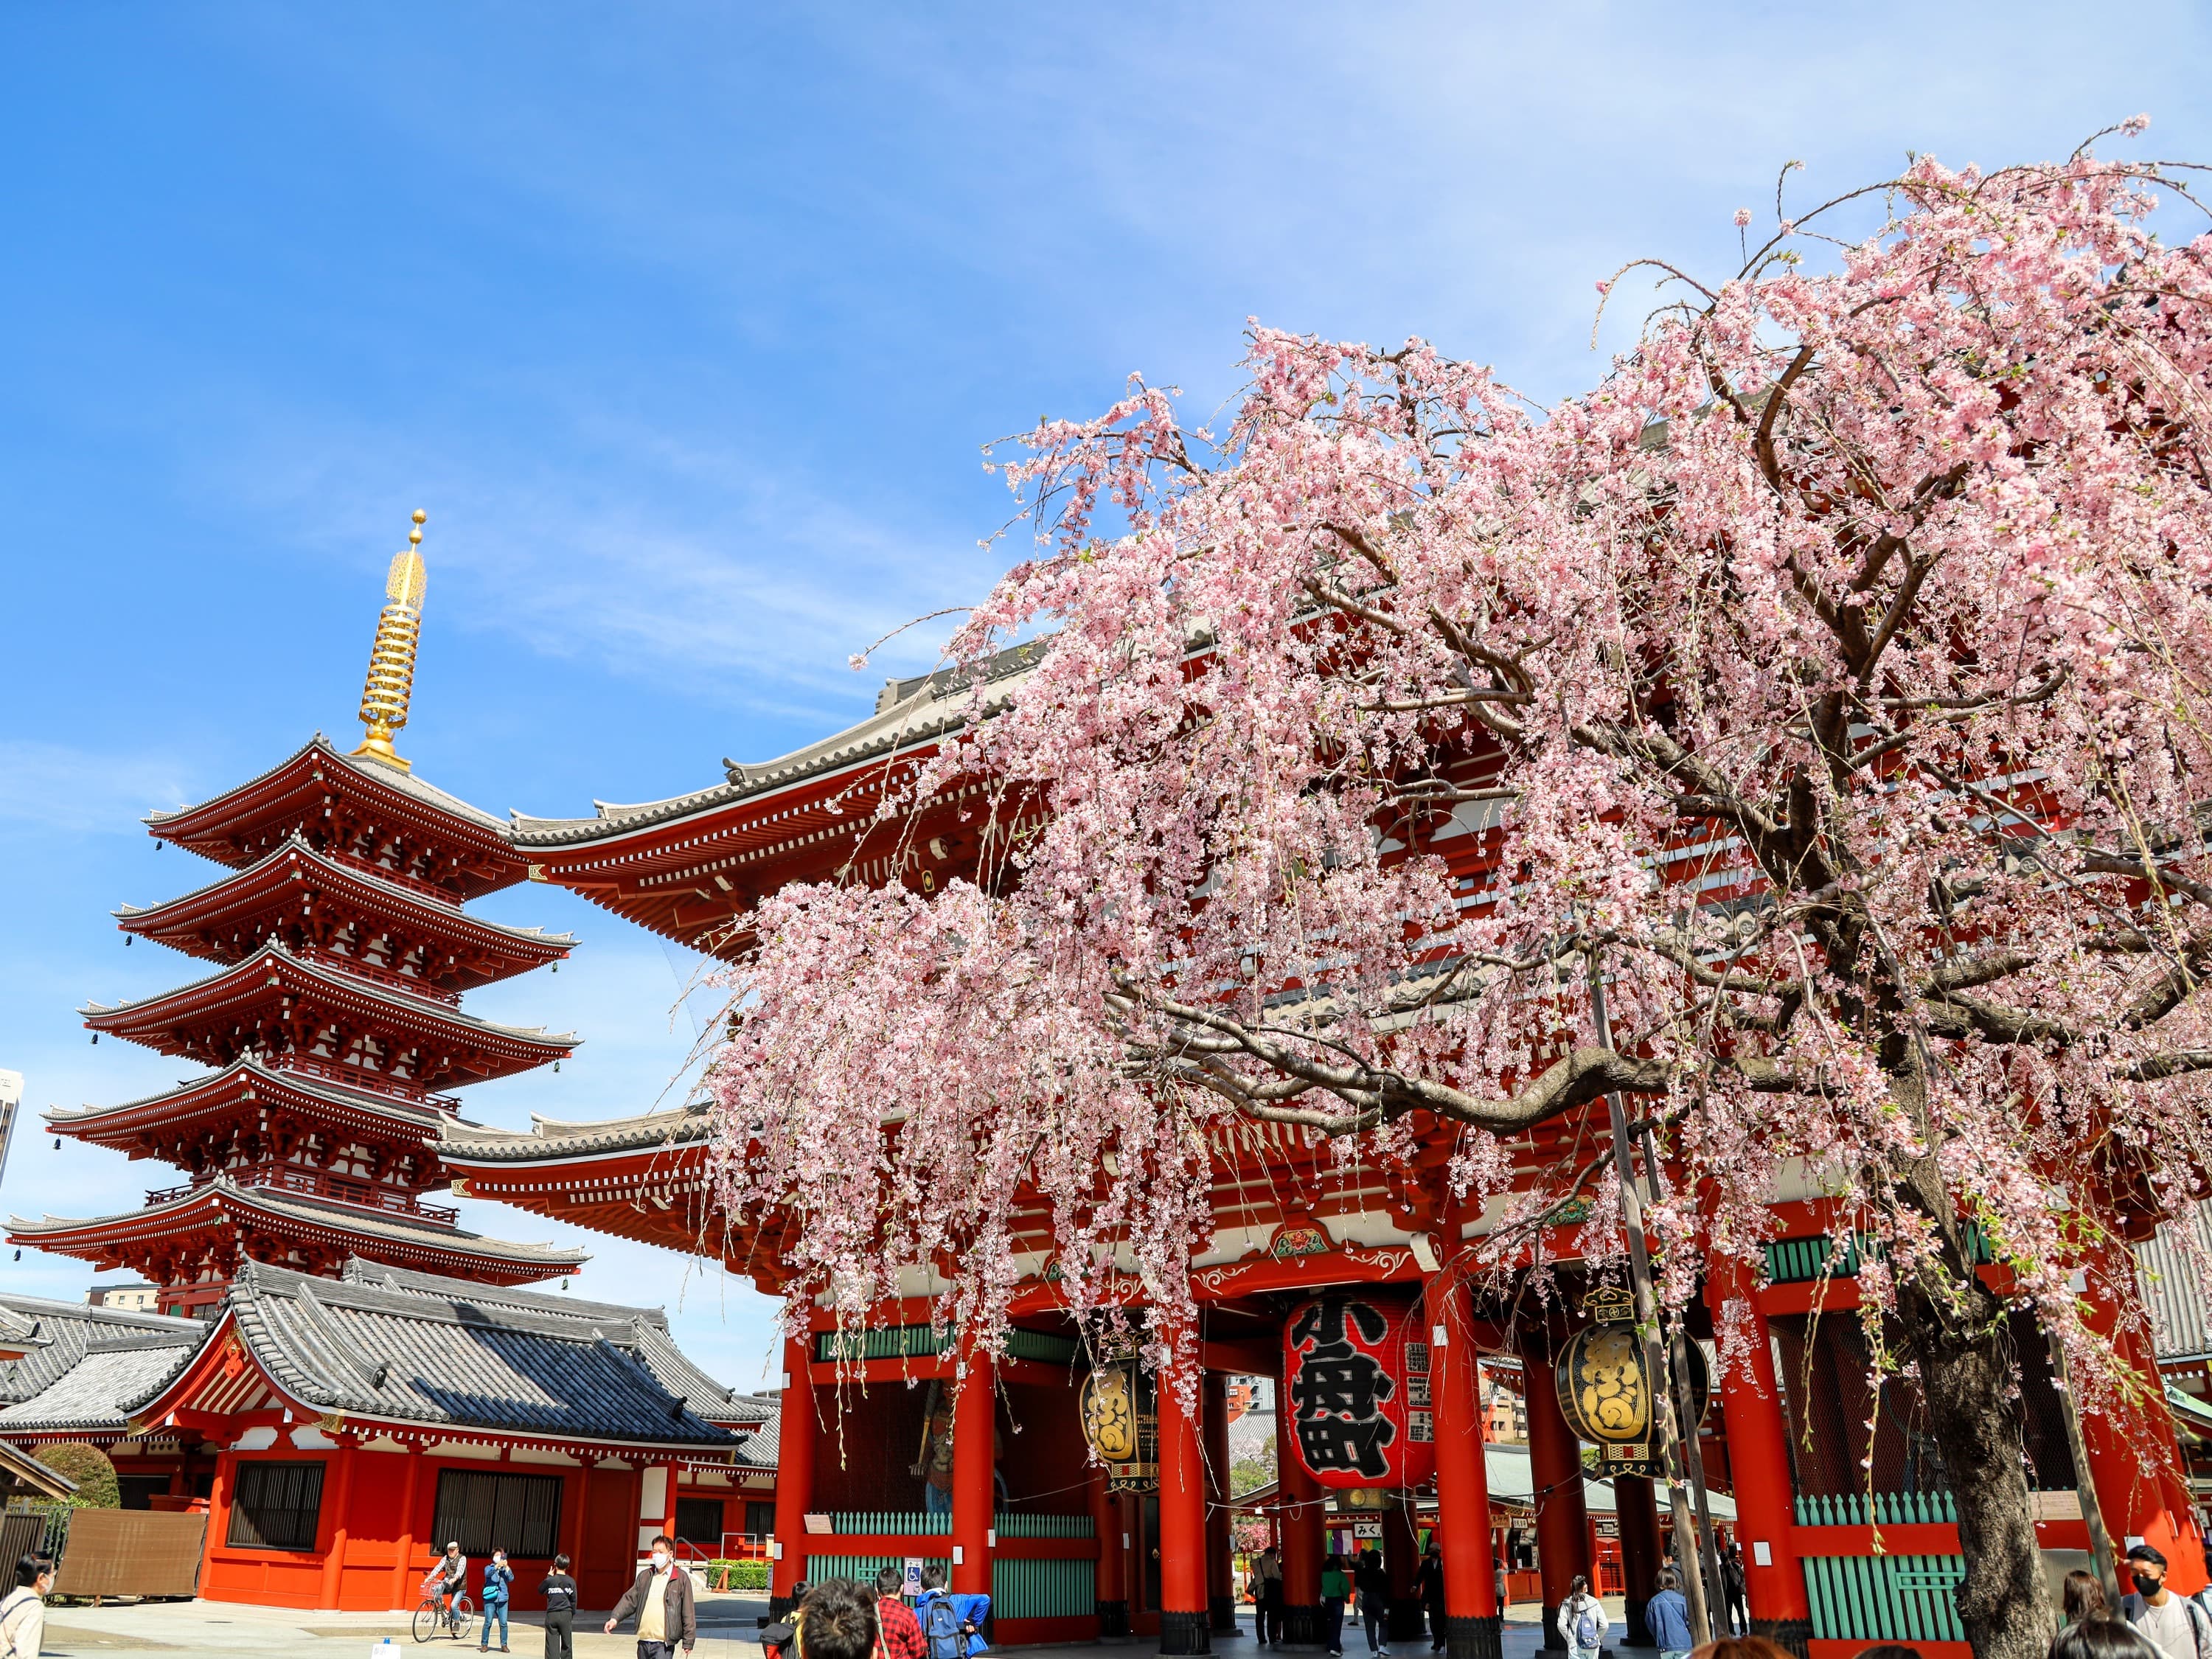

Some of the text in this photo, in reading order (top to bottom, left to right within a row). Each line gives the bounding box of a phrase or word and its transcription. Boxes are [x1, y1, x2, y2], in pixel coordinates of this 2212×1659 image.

[1290, 1297, 1397, 1480] 小舟町
[1358, 1526, 1382, 1536] みく
